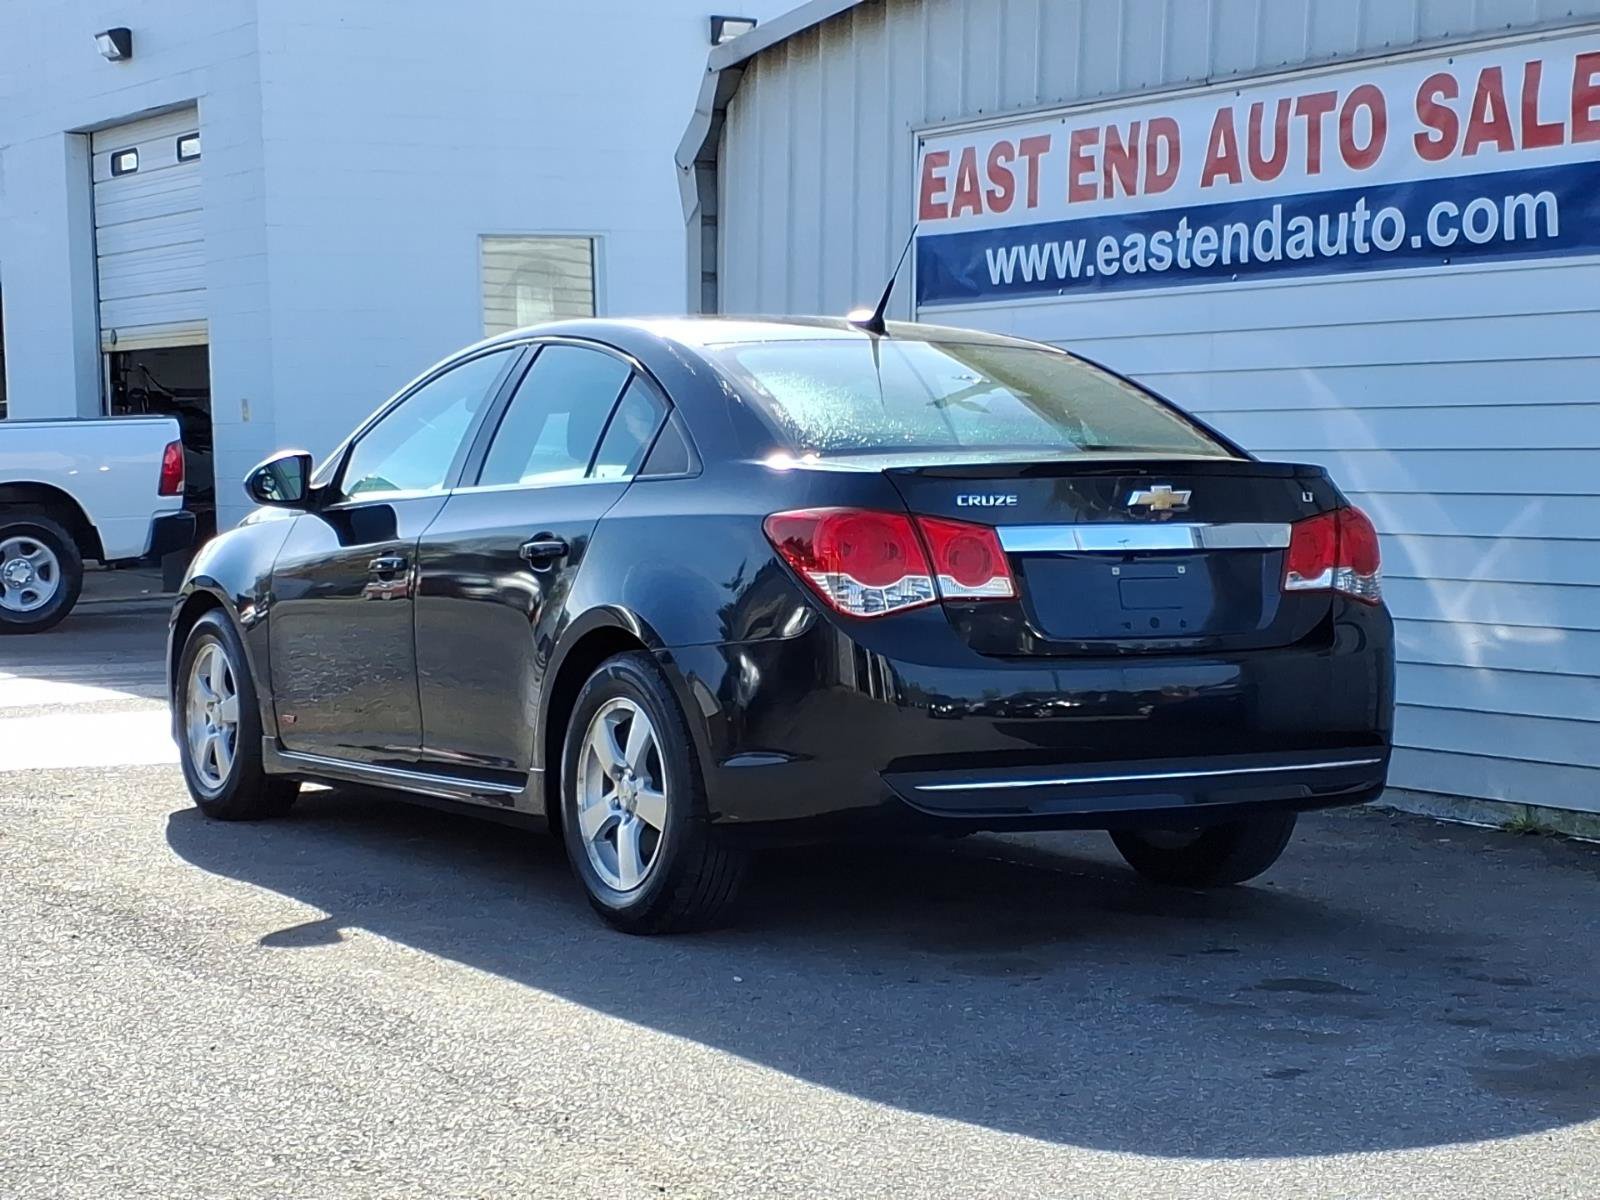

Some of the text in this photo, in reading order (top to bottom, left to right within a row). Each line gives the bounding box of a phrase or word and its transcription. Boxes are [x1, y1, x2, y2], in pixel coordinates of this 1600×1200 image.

[919, 135, 1051, 220] EAST
[1068, 117, 1182, 203] END
[1201, 84, 1388, 188] AUTO
[986, 190, 1560, 285] www.eastendauto.com
[956, 494, 1018, 507] CRUZE
